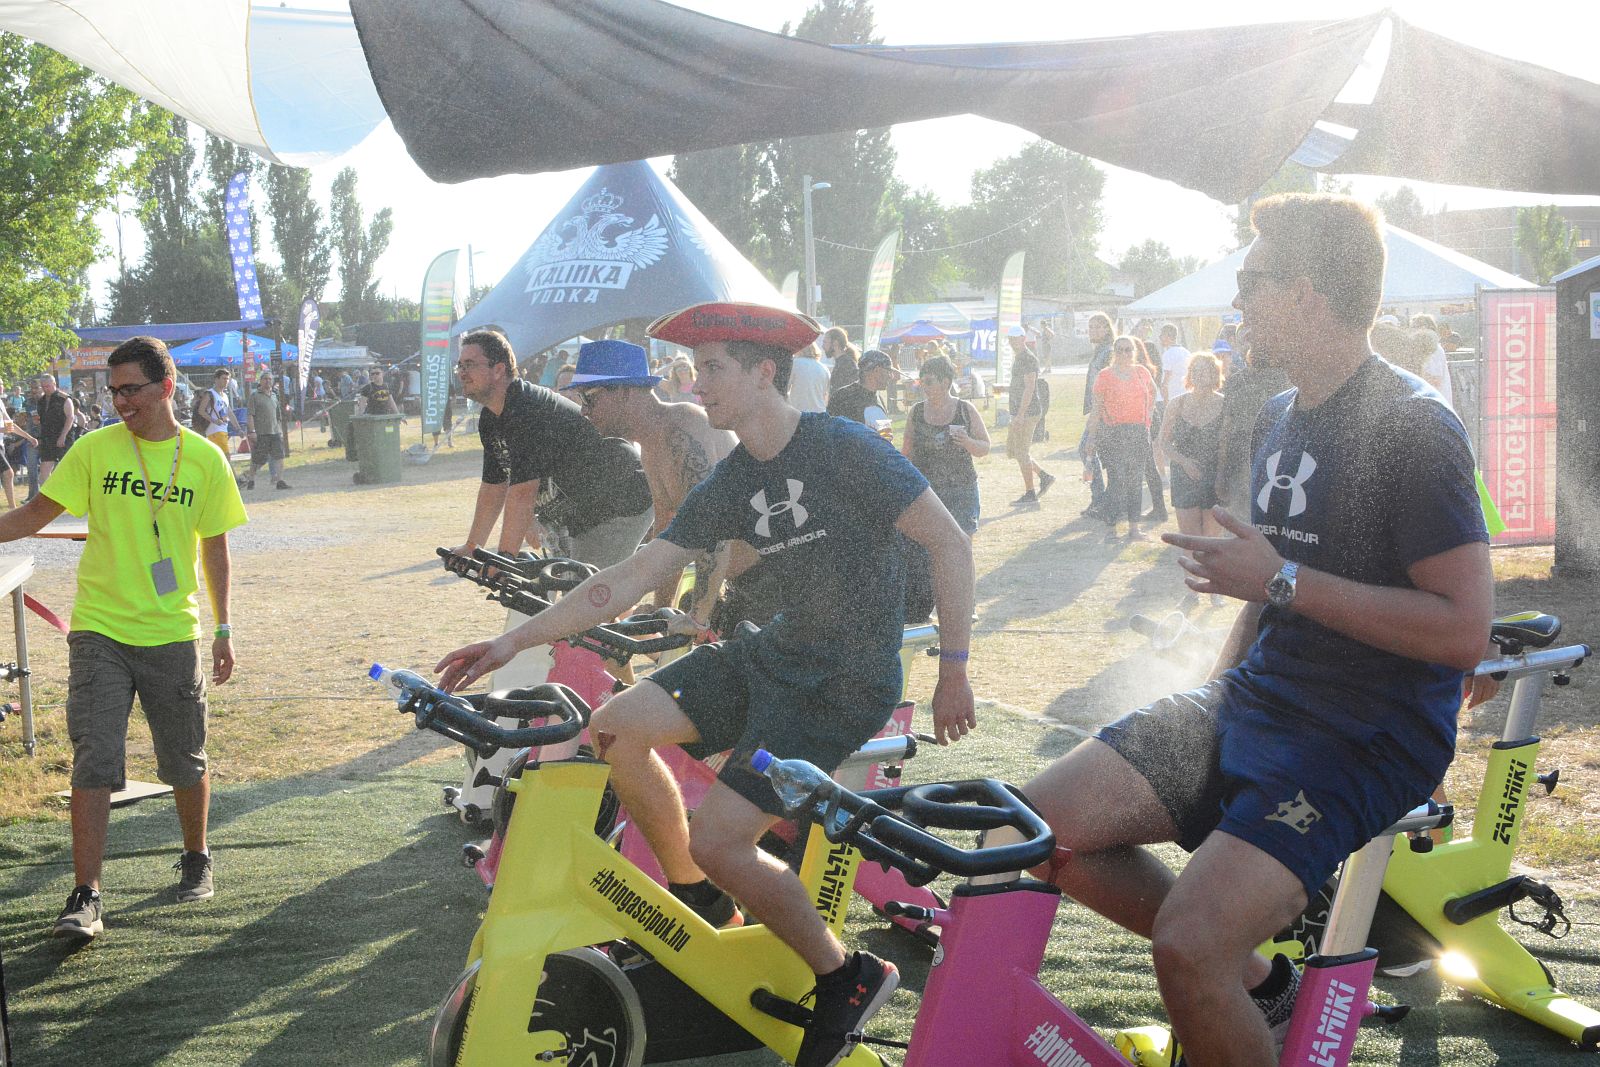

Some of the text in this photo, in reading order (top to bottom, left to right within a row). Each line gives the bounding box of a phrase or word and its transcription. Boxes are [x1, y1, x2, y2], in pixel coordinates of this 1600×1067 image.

[530, 288, 599, 306] VODKA
[531, 263, 622, 288] KALINKA
[103, 471, 194, 507] #fezen
[1252, 523, 1278, 535] NDER
[1493, 759, 1527, 845] ZALAMIKI
[589, 868, 691, 953] #bringascipok.hu
[816, 842, 853, 924] ALAMIKI
[1308, 978, 1356, 1067] LAMIKI
